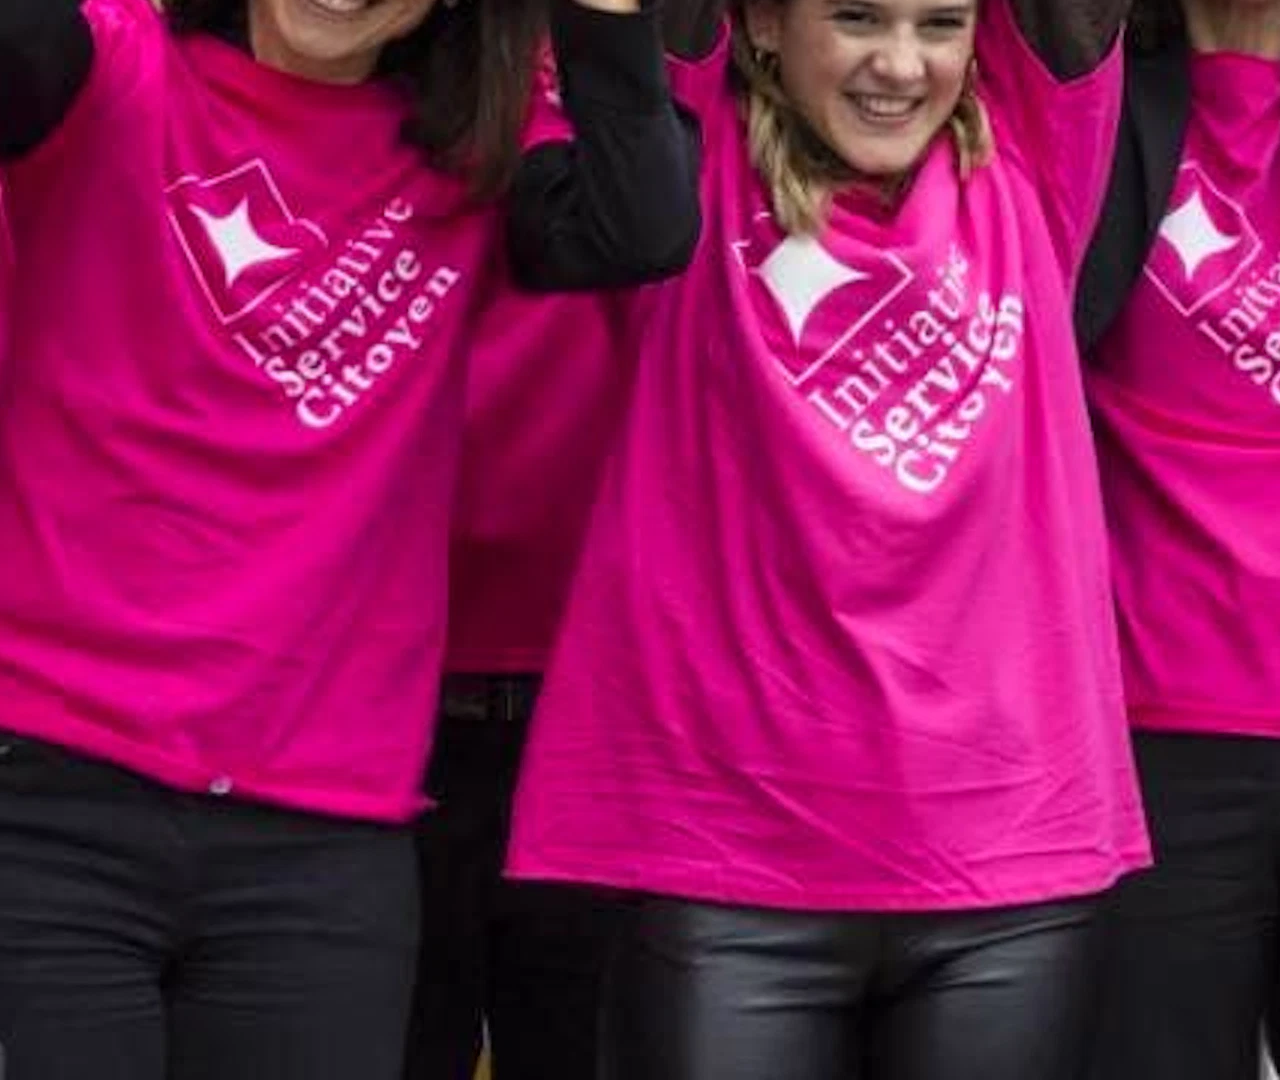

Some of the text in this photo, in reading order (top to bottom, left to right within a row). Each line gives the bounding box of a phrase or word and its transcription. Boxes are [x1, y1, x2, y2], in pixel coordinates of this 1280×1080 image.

[232, 196, 414, 367] Initiative
[265, 248, 422, 398] Service
[296, 264, 462, 429] Citoyen
[850, 291, 996, 467] Service
